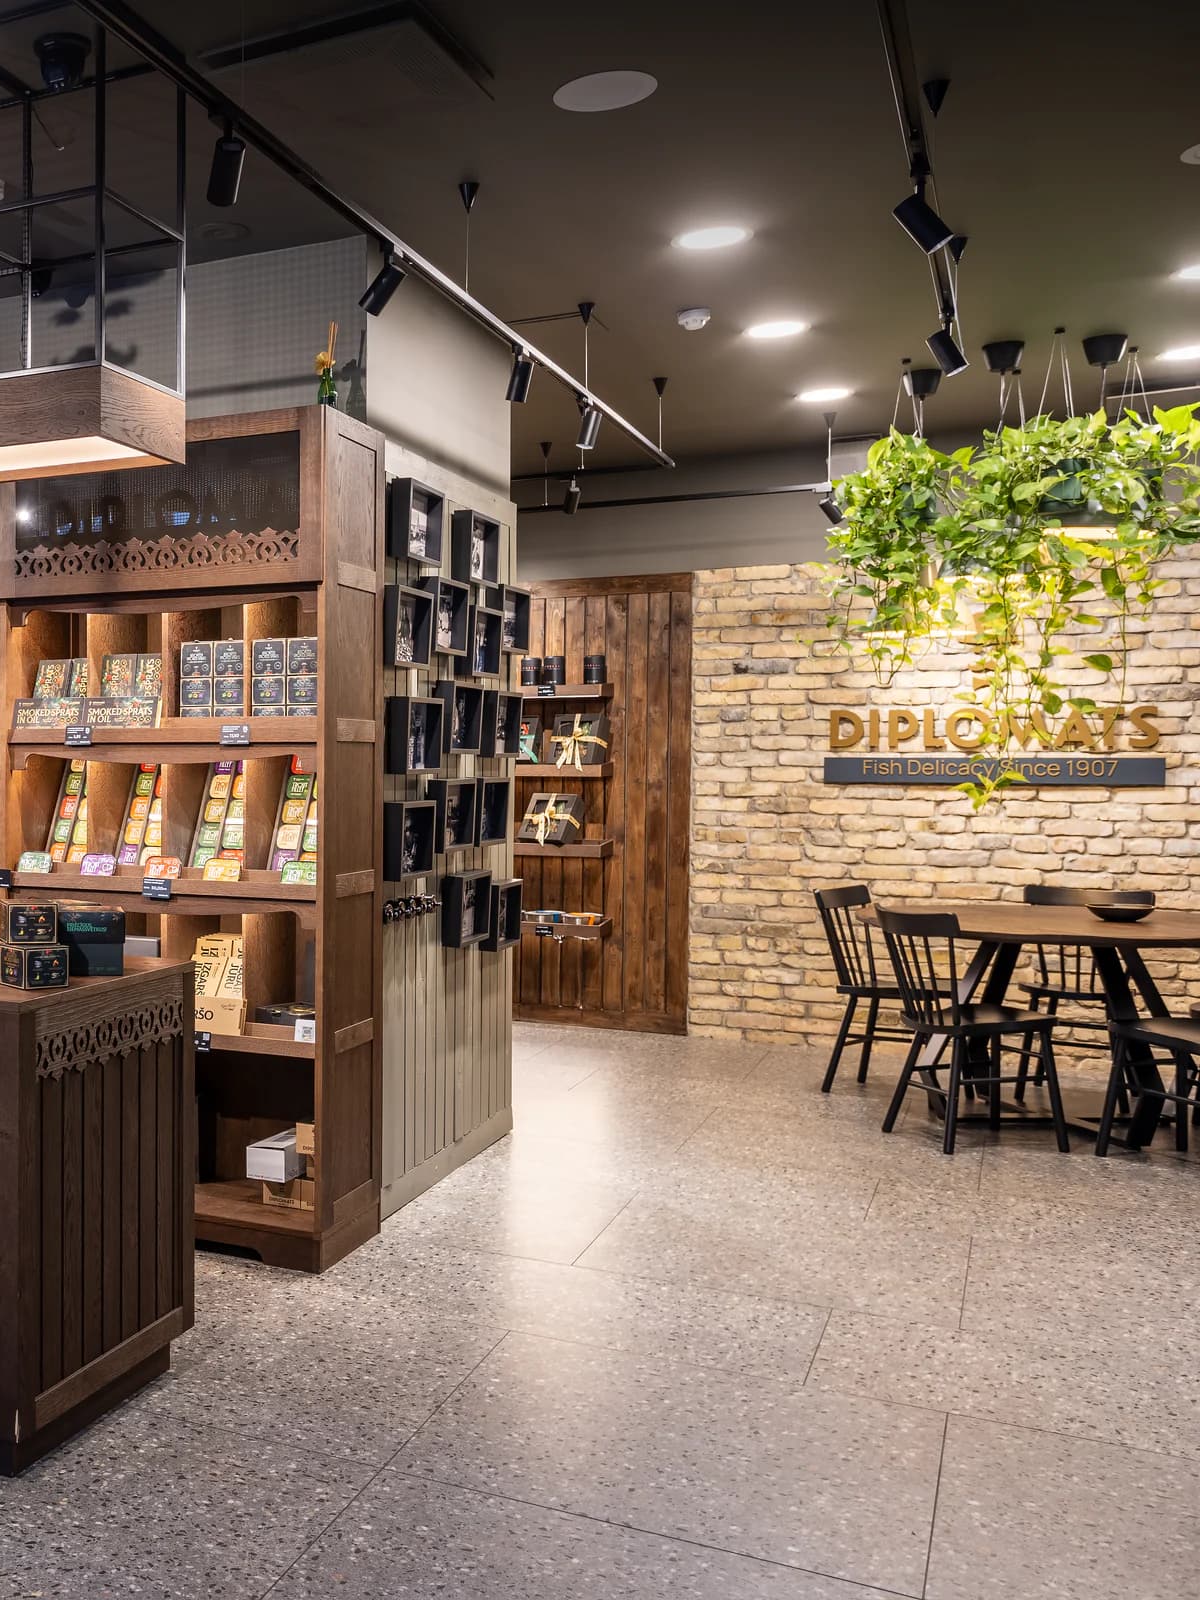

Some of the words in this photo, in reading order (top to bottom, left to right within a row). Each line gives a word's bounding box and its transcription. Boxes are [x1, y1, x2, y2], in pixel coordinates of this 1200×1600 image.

[17, 708, 50, 717] SMOKED
[51, 708, 79, 716] SPRATS
[88, 707, 122, 716] SMOKED
[123, 706, 153, 715] SPRATS
[16, 716, 26, 724] IN
[26, 716, 40, 724] OIL
[87, 715, 96, 723] IN
[96, 715, 111, 723] OIL
[829, 705, 1160, 749] DIPLOMATS
[862, 759, 902, 776] Fish
[907, 759, 995, 779] Delicacy
[1000, 759, 1061, 777] Since
[1066, 760, 1119, 777] 1907
